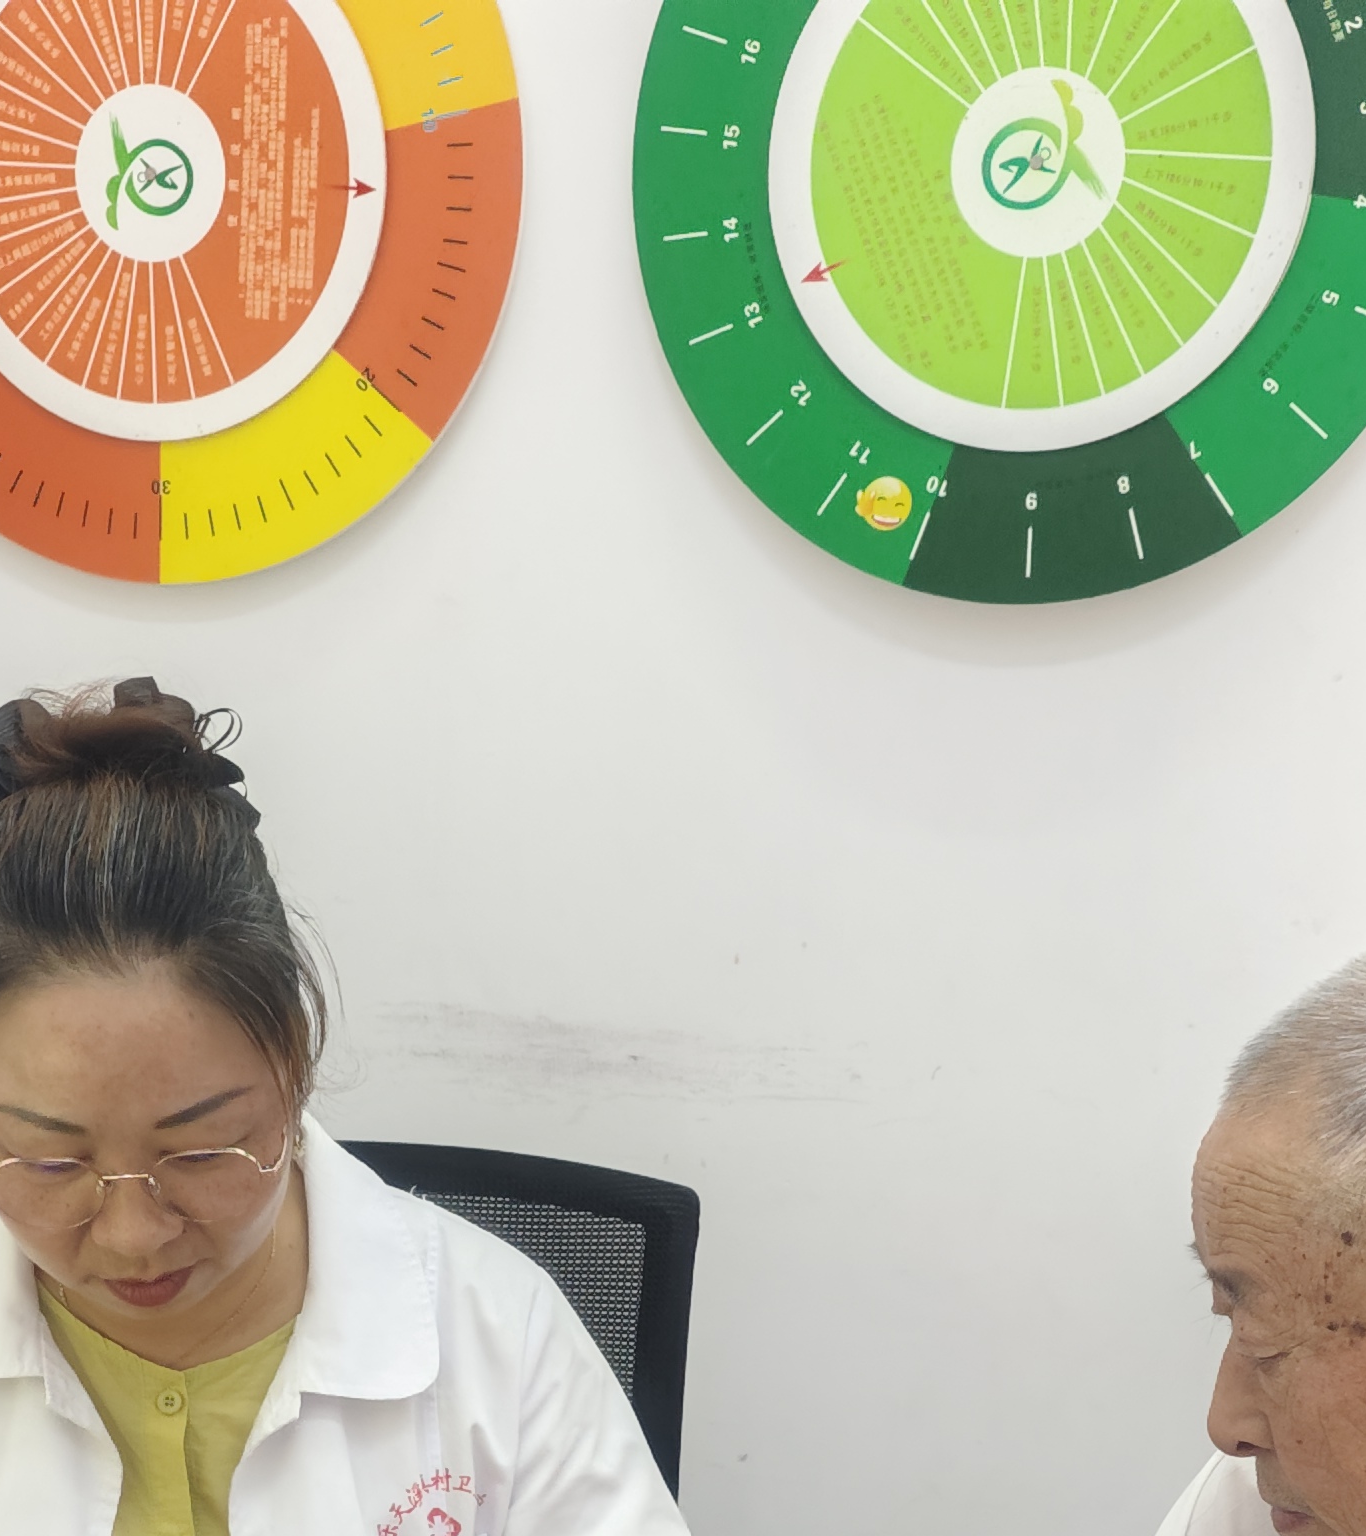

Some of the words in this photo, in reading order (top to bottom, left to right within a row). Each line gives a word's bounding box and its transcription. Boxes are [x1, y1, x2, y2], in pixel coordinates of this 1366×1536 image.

[1343, 16, 1363, 34] 2
[740, 38, 761, 64] 16
[722, 124, 741, 149] 15
[722, 217, 740, 243] 14
[1322, 289, 1340, 306] 5
[744, 301, 764, 328] 13
[355, 366, 376, 391] 20
[1262, 377, 1279, 395] 6
[790, 379, 812, 406] 12
[849, 440, 870, 465] 11
[1189, 440, 1202, 460] 7
[151, 480, 171, 495] 30
[925, 475, 948, 498] 10
[1116, 475, 1131, 495] 8
